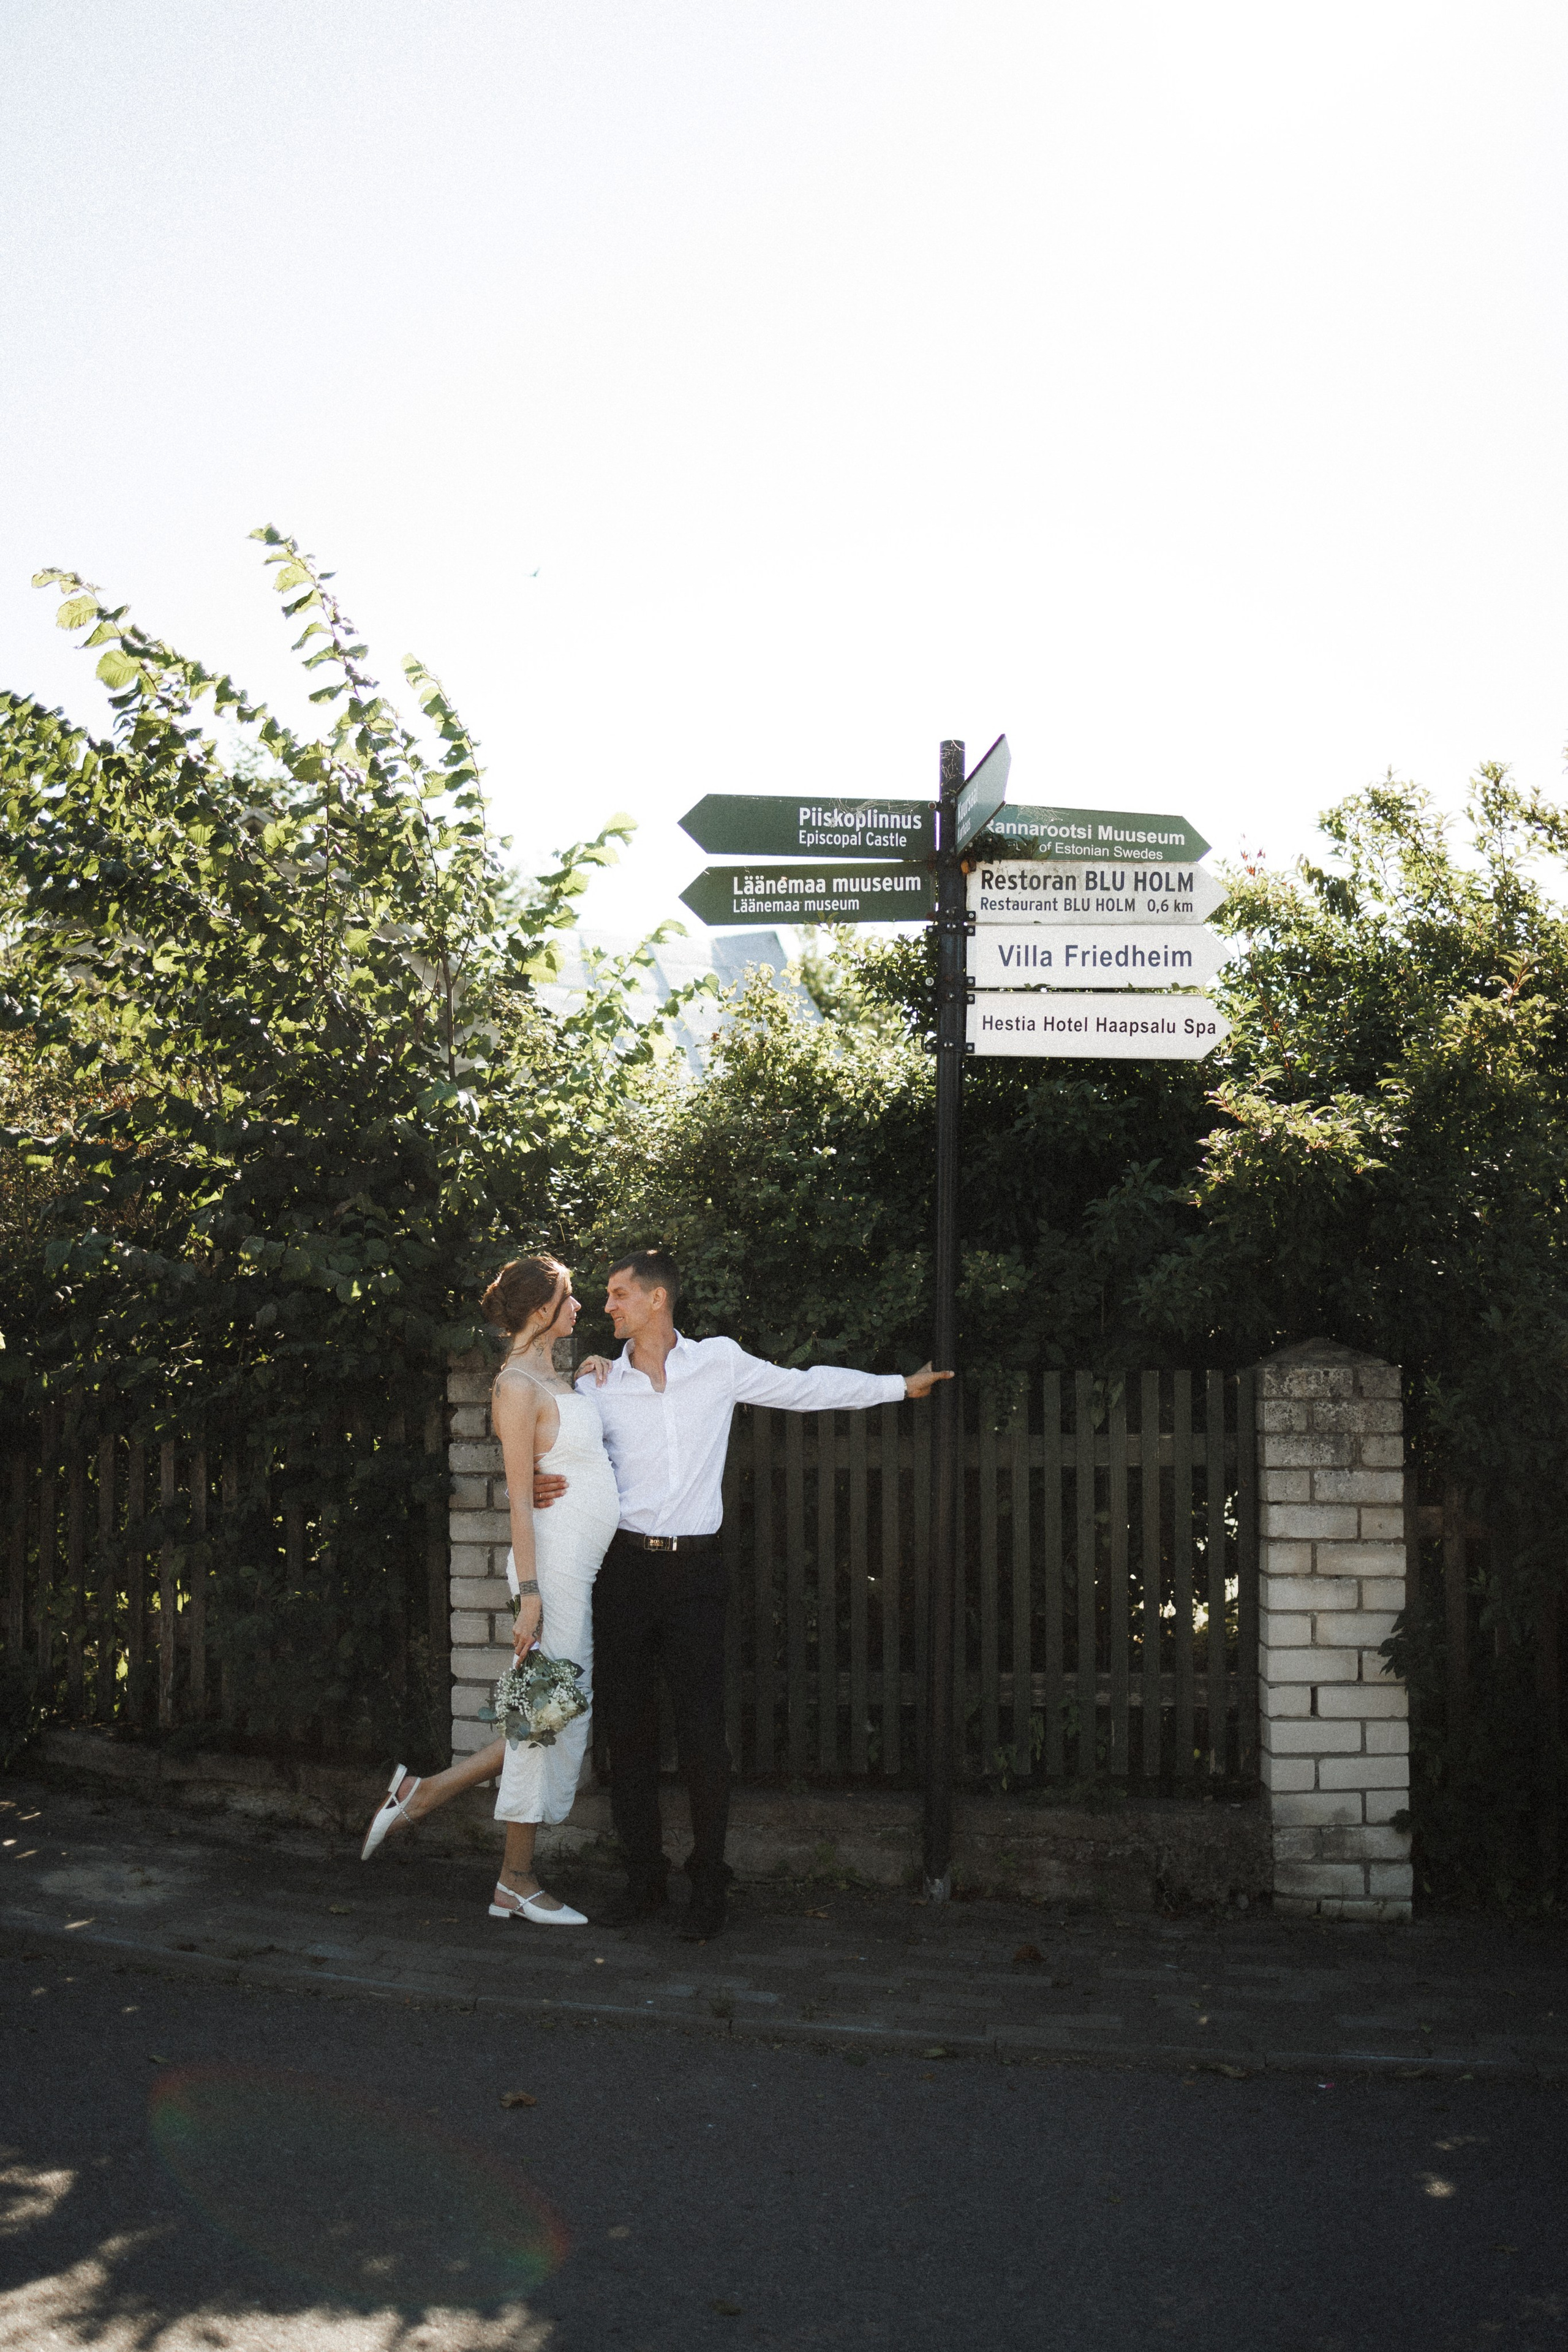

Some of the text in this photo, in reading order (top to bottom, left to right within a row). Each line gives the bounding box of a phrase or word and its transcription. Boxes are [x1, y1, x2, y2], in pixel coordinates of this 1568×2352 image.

[799, 807, 922, 832] Piiskoplinnus
[799, 831, 907, 848] Episcopal Castle
[1098, 826, 1185, 845] Muuseum
[1055, 842, 1110, 857] Estonian
[1114, 846, 1163, 860] Swedes
[733, 875, 922, 895] Läänemaa muuseum
[981, 870, 1194, 892] Restoran BLU HOLM
[733, 898, 860, 913] Läänemaa museum
[981, 897, 1193, 914] Restaurant BLU HOLM 0,6 km
[998, 944, 1193, 967] Villa Friedheim
[982, 1015, 1216, 1038] Hestia Hotel Haapsalu Spa
